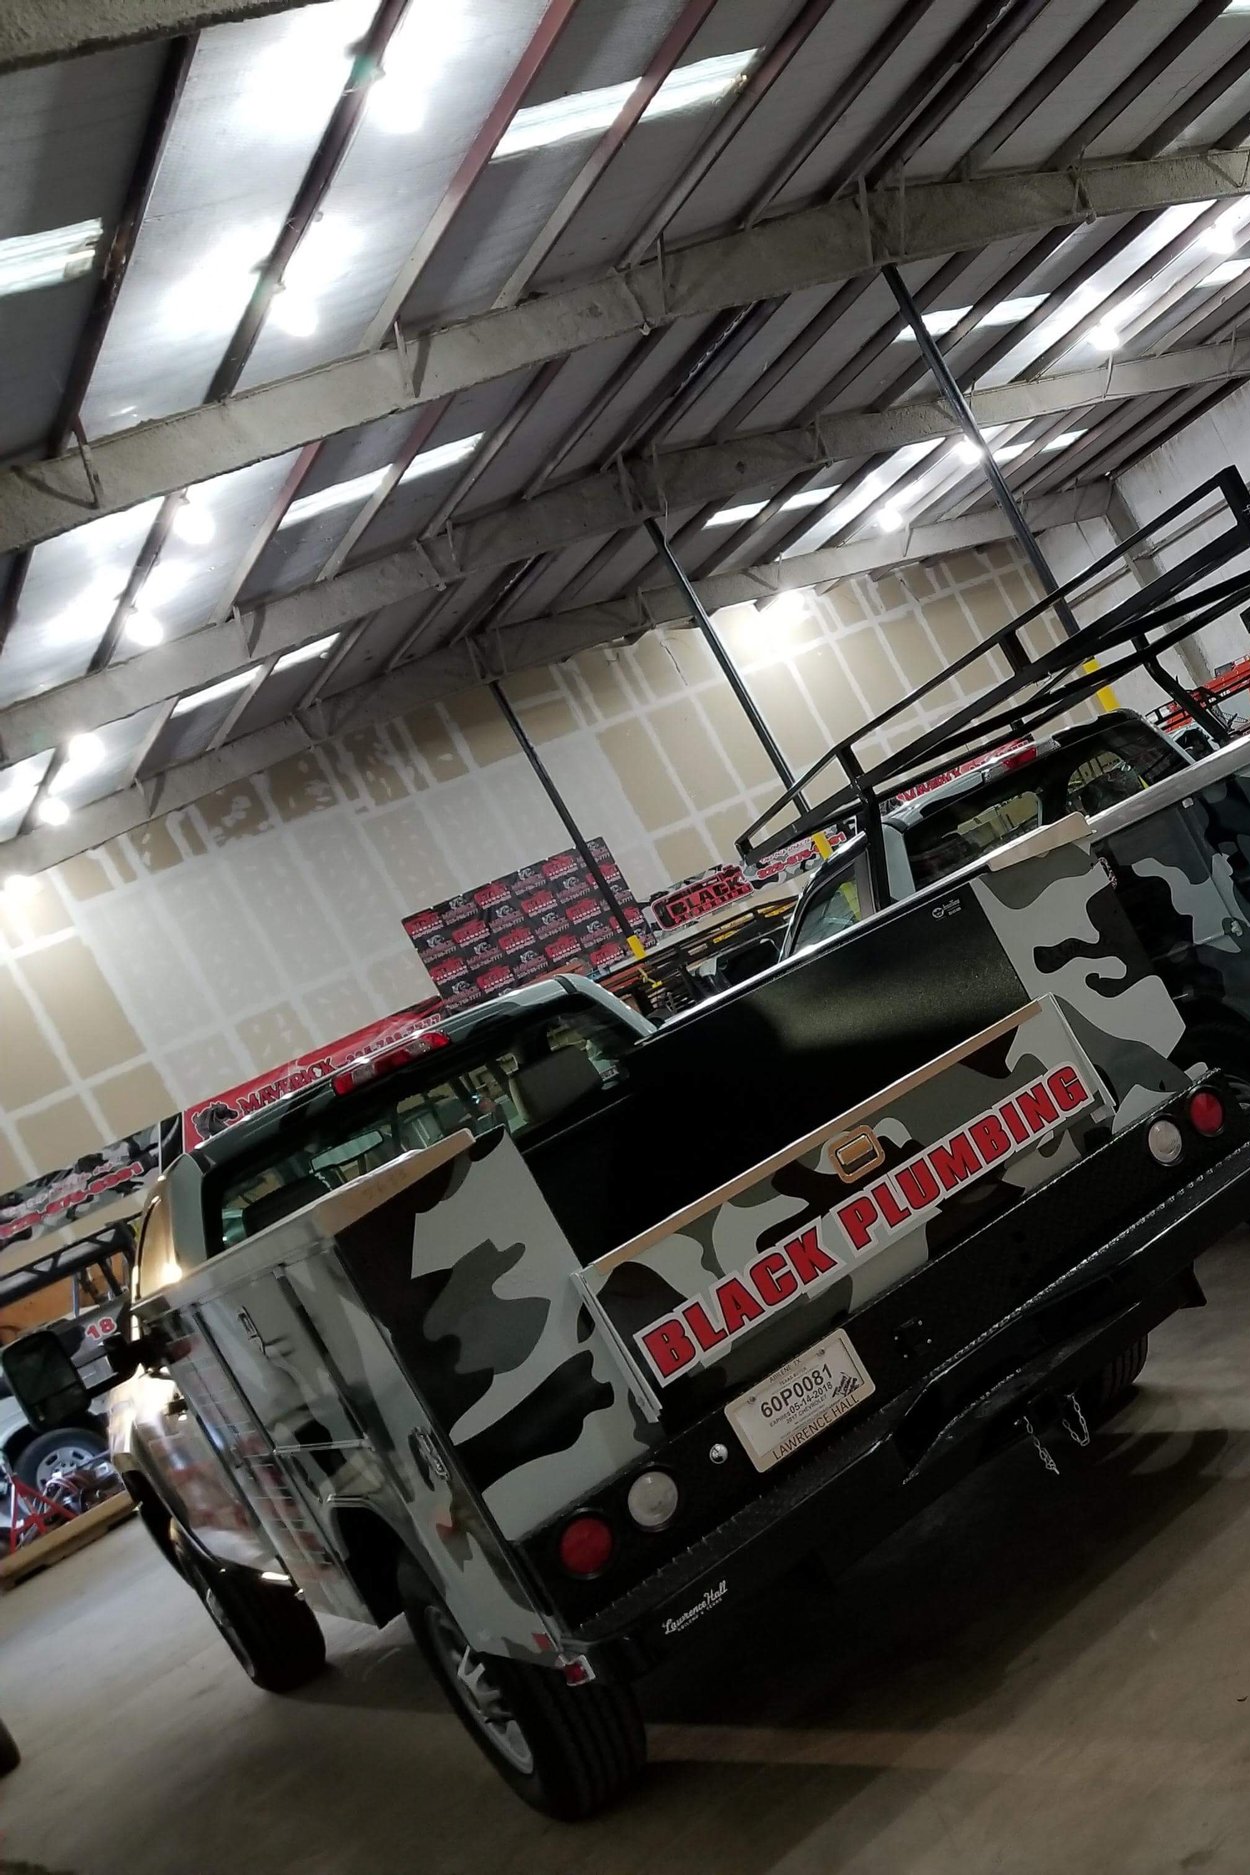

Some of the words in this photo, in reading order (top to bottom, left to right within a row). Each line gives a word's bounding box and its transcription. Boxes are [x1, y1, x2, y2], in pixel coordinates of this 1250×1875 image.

[671, 876, 743, 916] BLACK
[238, 1058, 335, 1116] MAVERICK
[643, 1226, 838, 1379] BLACK
[837, 1065, 1089, 1251] PLUMBING
[85, 1316, 117, 1341] 18
[761, 1363, 832, 1418] 60P0081
[789, 1381, 833, 1415] 05-14-2018
[772, 1412, 833, 1460] LAWRENCE
[831, 1393, 860, 1418] HALL
[661, 1600, 707, 1635] Lawrence
[703, 1579, 728, 1605] Hall
